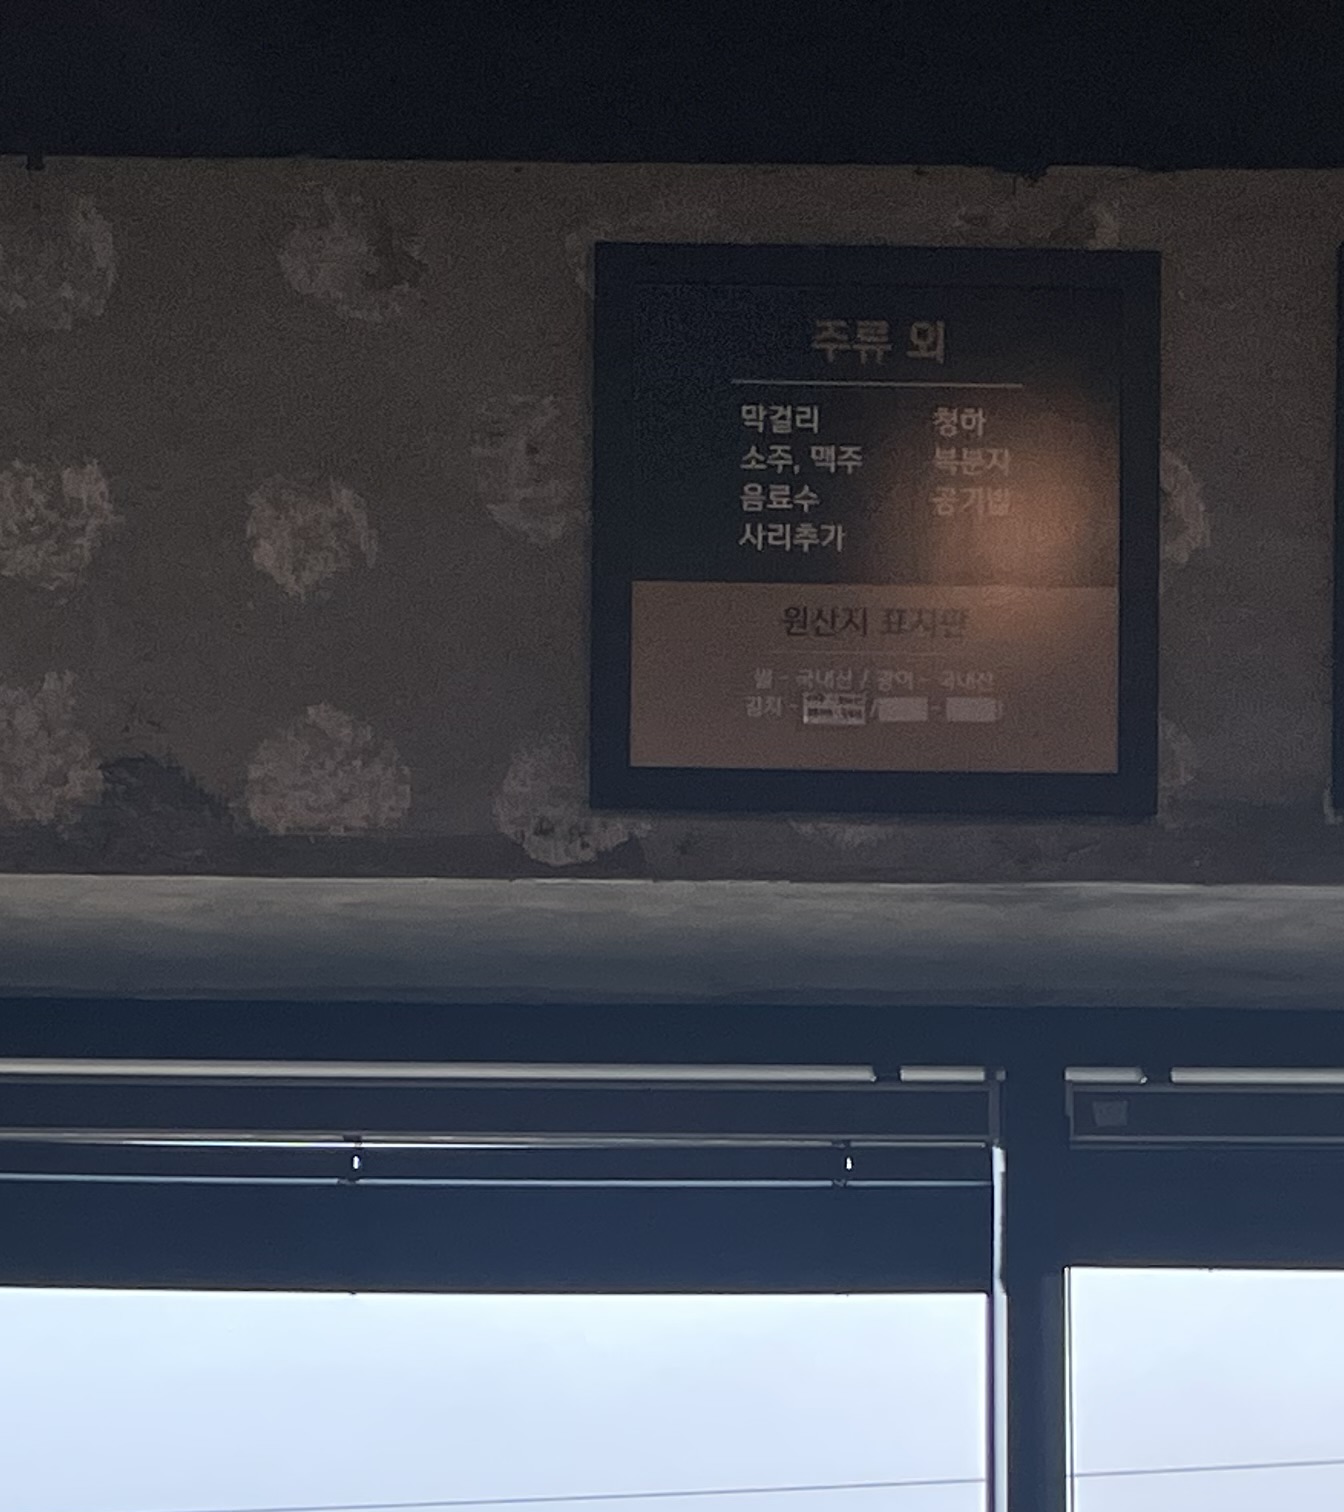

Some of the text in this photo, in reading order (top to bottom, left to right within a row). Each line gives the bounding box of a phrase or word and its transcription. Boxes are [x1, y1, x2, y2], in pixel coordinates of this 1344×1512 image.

[811, 319, 946, 365] 주류 외
[740, 404, 820, 434] 막걸리
[933, 407, 987, 437] 청하
[739, 445, 863, 475] 소주, 맥주
[739, 483, 820, 512] 음료수
[738, 523, 846, 553] 사리추가
[781, 605, 869, 638] 원산지
